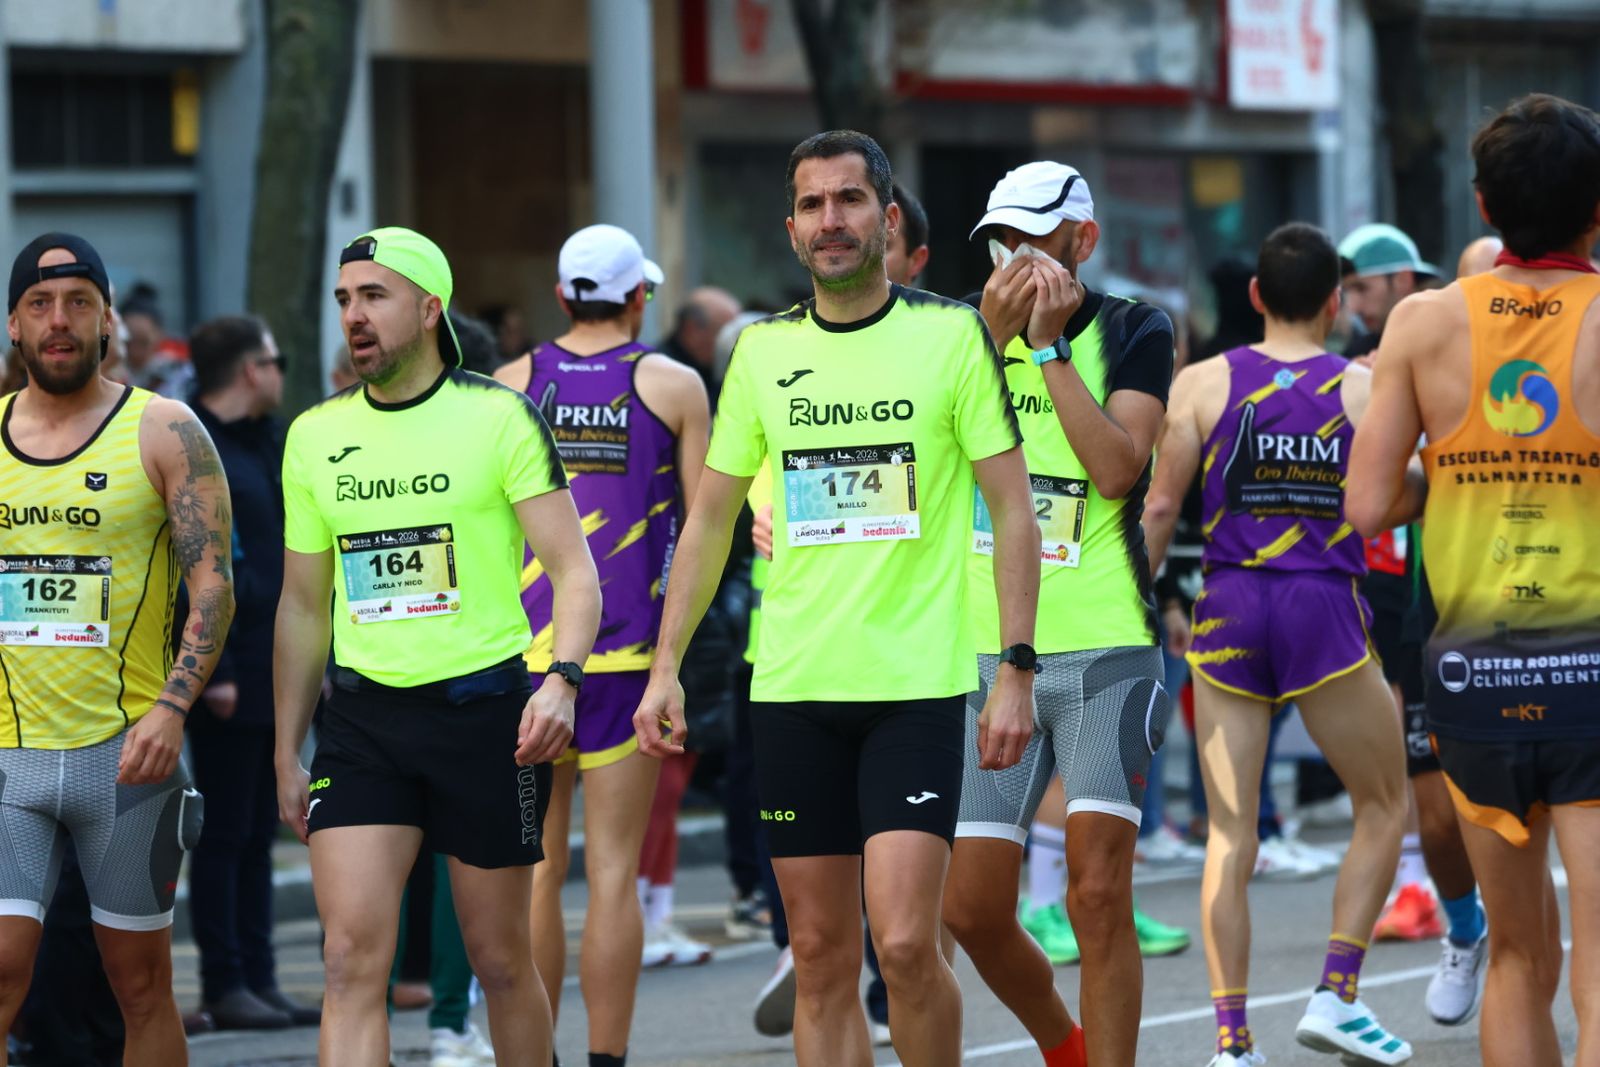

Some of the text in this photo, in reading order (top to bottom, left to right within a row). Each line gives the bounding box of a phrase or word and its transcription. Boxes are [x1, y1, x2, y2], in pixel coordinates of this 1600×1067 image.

[1489, 297, 1563, 319] BRAVO
[555, 405, 628, 428] PRIM
[855, 449, 878, 459] 2026
[1257, 434, 1341, 463] PRIM
[1438, 450, 1600, 468] ESCUELA TRIATLÓ
[822, 469, 882, 496] 174
[1033, 478, 1054, 488] 2026
[1455, 472, 1582, 485] SALMANTINA
[837, 501, 867, 509] MAILLO
[398, 531, 420, 541] 2026
[55, 559, 76, 568] 2026
[369, 550, 424, 577] 164
[22, 578, 76, 602] 162
[373, 582, 396, 590] CARLA
[1473, 652, 1600, 670] ESTER RODRÍGU
[1473, 670, 1600, 687] CLÍNICA DENT
